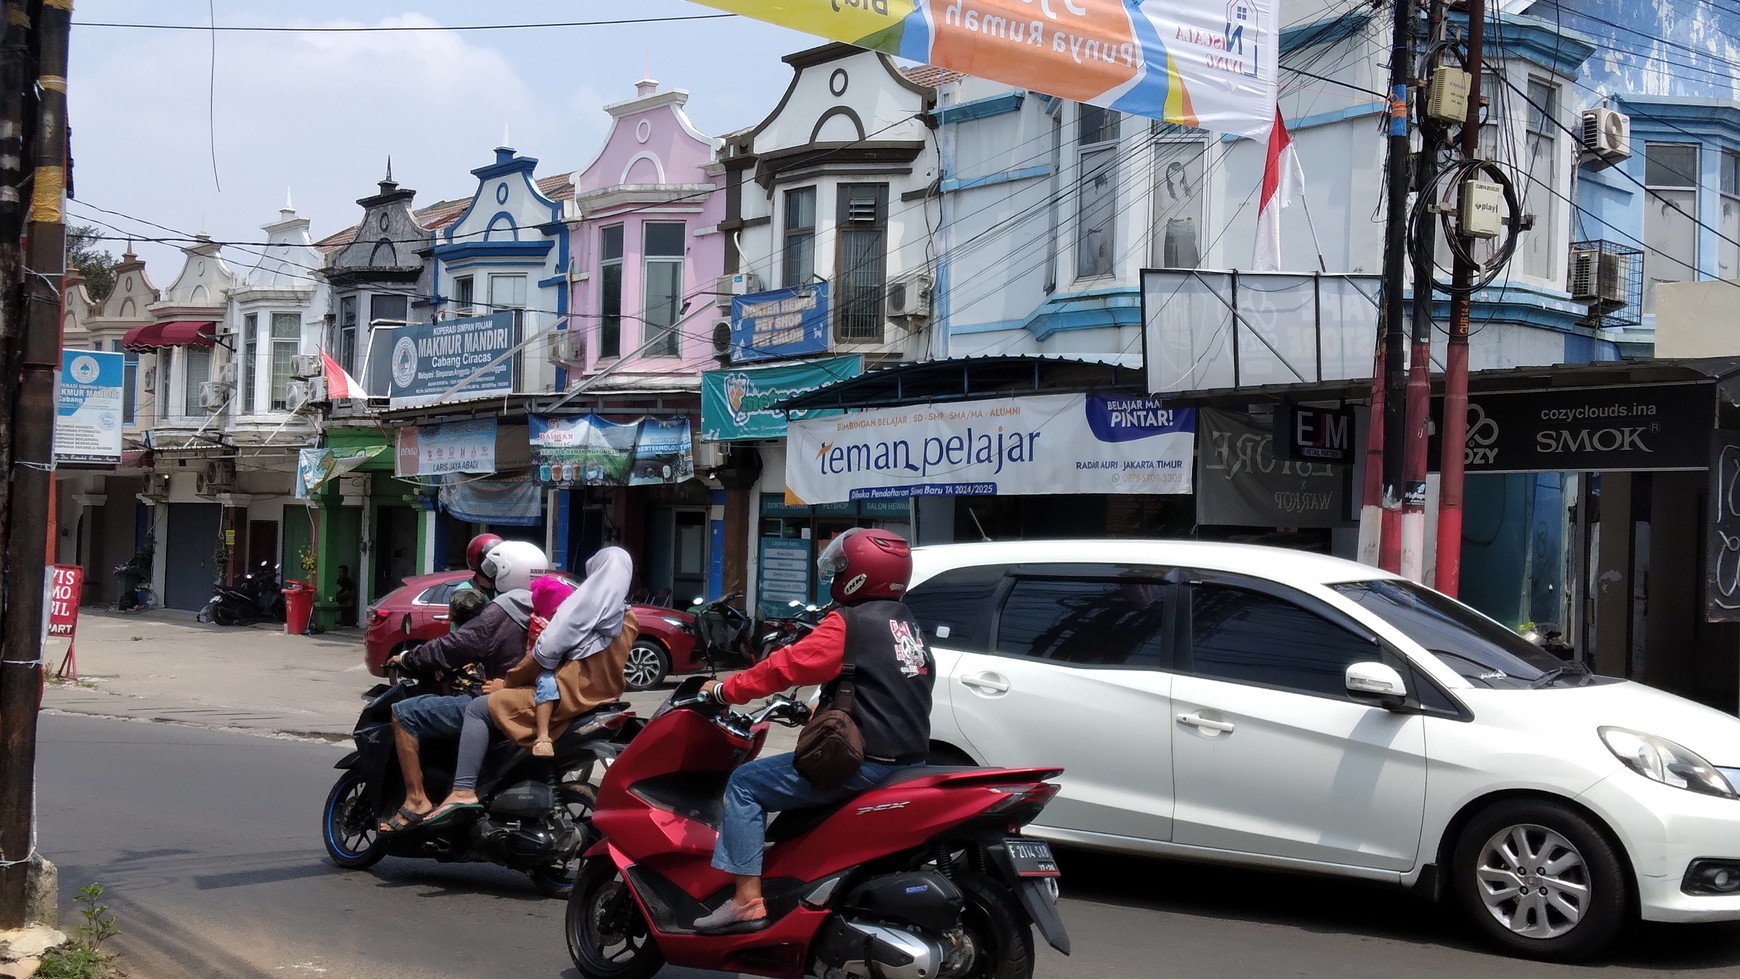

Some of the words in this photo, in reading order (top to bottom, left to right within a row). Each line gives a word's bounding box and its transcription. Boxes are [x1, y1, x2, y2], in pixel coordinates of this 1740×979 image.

[742, 300, 780, 318] DOKTER
[433, 325, 456, 336] KOPERASI
[457, 322, 474, 333] SIMPAN
[475, 320, 492, 330] PINJAM
[754, 317, 774, 332] PET
[774, 313, 802, 330] SHOP
[418, 334, 461, 358] MAKMUR
[464, 327, 508, 353] MANDIRI
[770, 328, 805, 346] SALON
[432, 356, 460, 368] Cabang
[463, 352, 491, 365] Ciracas
[61, 388, 84, 396] KMUR
[1107, 400, 1142, 412] BELAJAR
[1541, 403, 1657, 423] cozyclouds.ina
[836, 419, 876, 432] BIMBINGAN
[877, 415, 908, 427] BELAJAR
[913, 414, 924, 423] SD
[928, 412, 945, 421] SMP
[949, 409, 984, 420] SMA/MA
[990, 407, 1021, 418] ALUMNI
[1111, 410, 1174, 428] PINTAR!
[1297, 410, 1348, 450] EJM
[1536, 426, 1654, 453] SMOK
[400, 447, 418, 456] DENSO
[816, 439, 920, 475] teman
[922, 425, 1041, 476] pelajar
[1463, 447, 1499, 465] OZY
[433, 461, 449, 472] LARIS
[1076, 461, 1100, 470] RADAR
[1101, 460, 1118, 469] AURI
[1123, 460, 1154, 471] JAKARTA
[1156, 460, 1182, 469] TIMUR
[851, 490, 870, 499] Dibuka
[870, 487, 909, 498] Pendaftaran
[924, 485, 943, 495] Baru
[945, 485, 953, 494] TA
[954, 484, 993, 495] 2024/2025
[866, 502, 888, 510] SALON
[888, 502, 910, 510] HEWAN
[846, 576, 863, 593] INK
[1008, 845, 1016, 858] F
